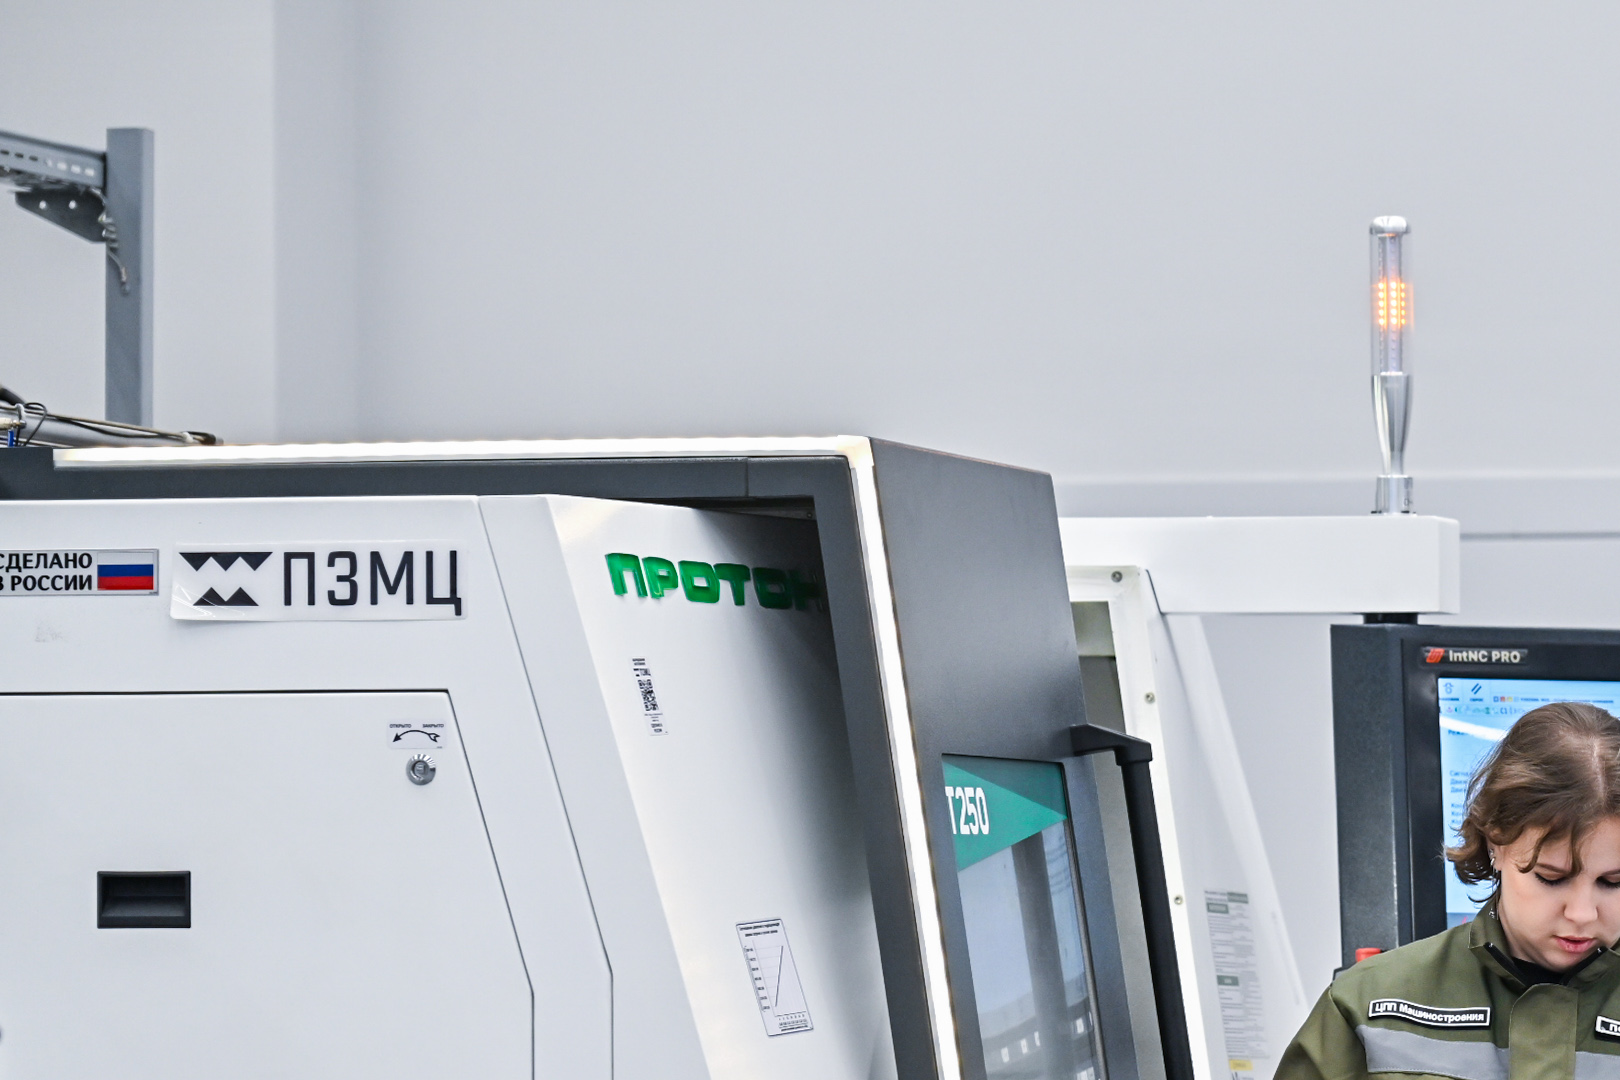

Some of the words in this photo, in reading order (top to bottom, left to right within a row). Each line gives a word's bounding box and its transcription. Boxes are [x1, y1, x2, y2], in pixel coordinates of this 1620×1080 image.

[11, 575, 92, 591] РОССИИ
[284, 550, 462, 616] ПЗМЦ
[1449, 650, 1488, 662] IntNC
[1491, 651, 1521, 663] PRO
[1400, 1004, 1484, 1023] Машиностроения
